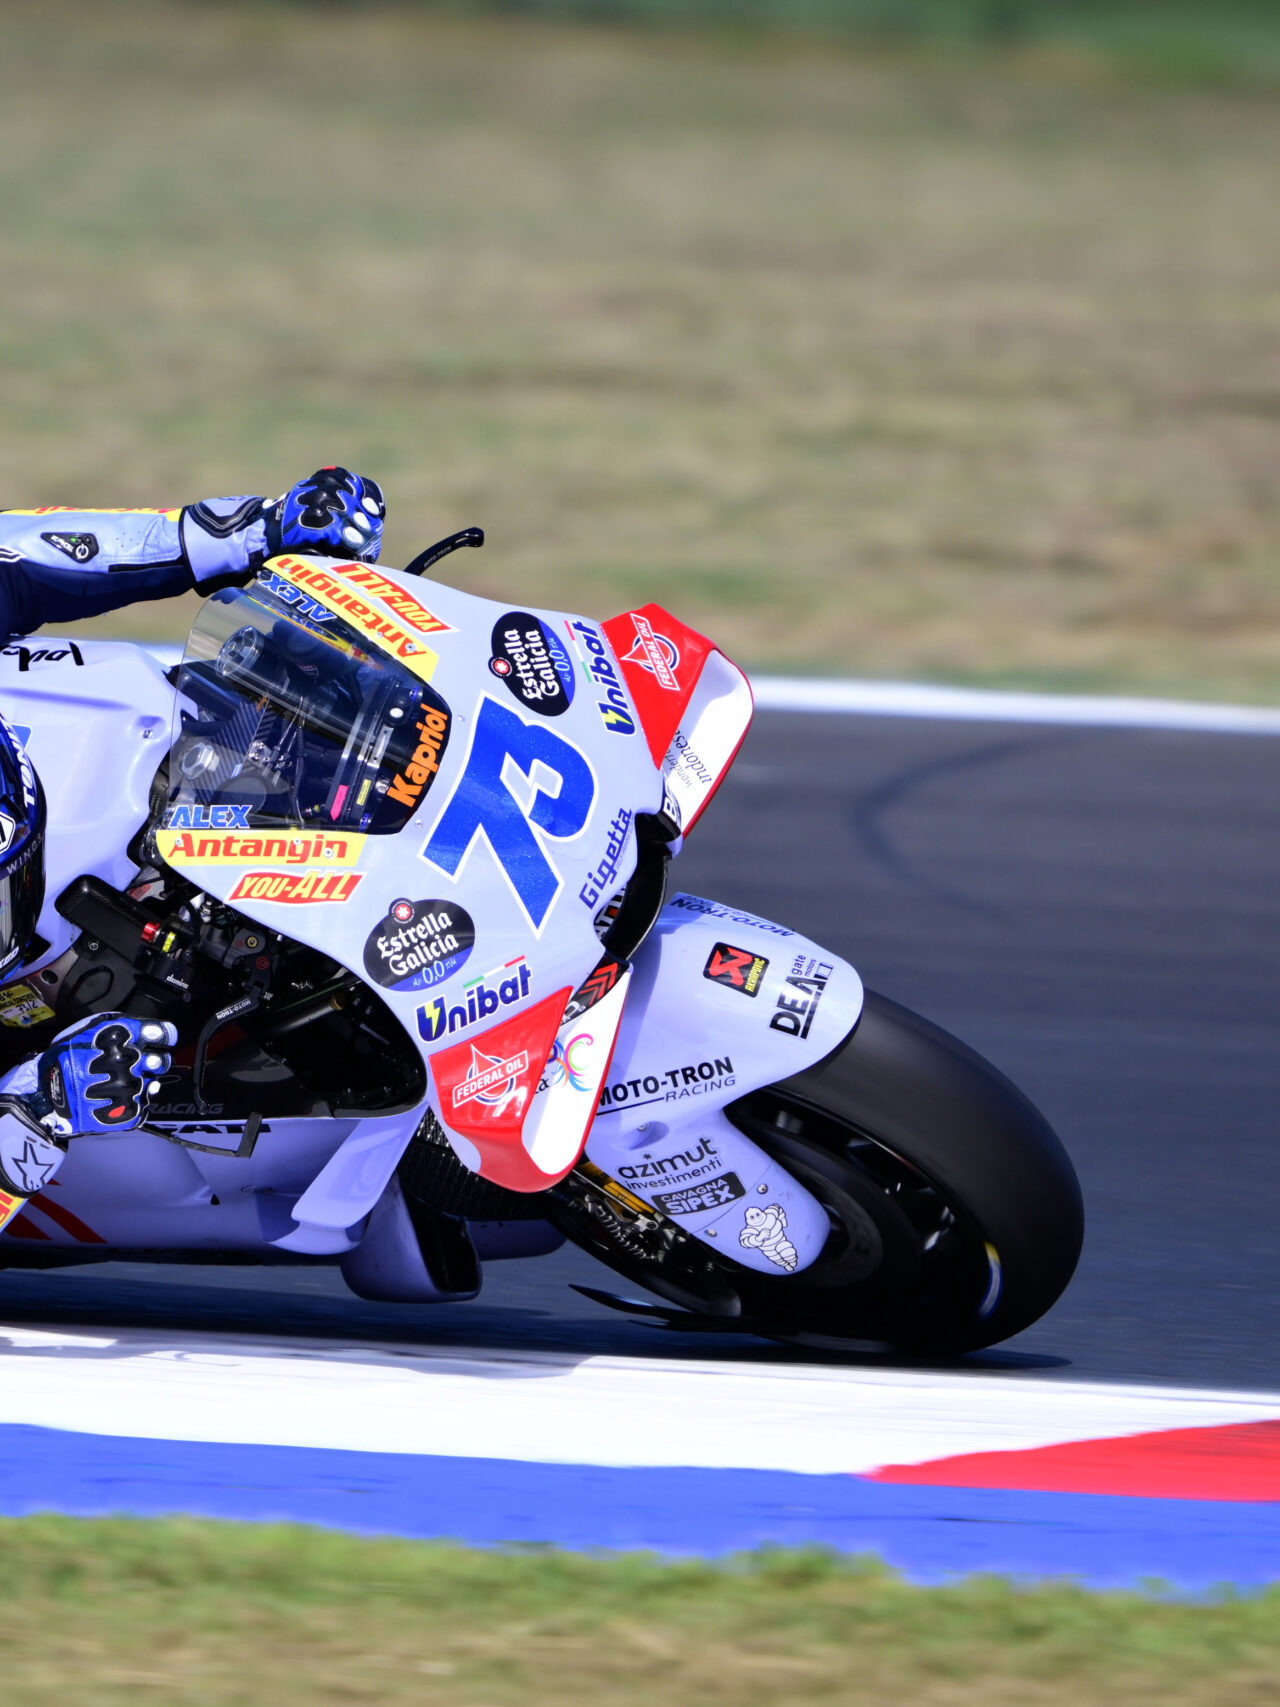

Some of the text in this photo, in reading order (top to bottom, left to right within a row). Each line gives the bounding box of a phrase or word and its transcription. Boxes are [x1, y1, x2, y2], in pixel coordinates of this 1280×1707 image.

[260, 573, 337, 622] ALEX
[276, 557, 428, 659] Antangin
[336, 563, 444, 633] YOU-ALL
[504, 628, 543, 700] Estrella
[525, 629, 560, 696] Galicia
[637, 622, 673, 686] FEDERAL OIL
[571, 620, 636, 736] Unibat
[387, 703, 449, 809] Kapriol
[168, 805, 254, 829] ALEX
[417, 690, 599, 940] 73
[6, 832, 43, 875] WINGS
[168, 833, 348, 864] Antangin
[578, 808, 633, 910] Gigetta
[238, 870, 355, 899] YOU-ALL
[377, 912, 453, 959] Estrella
[671, 898, 795, 937] MOTO-TRON
[389, 934, 459, 976] Galicia
[791, 954, 807, 976] gate
[416, 963, 531, 1042] Unibat
[456, 1058, 524, 1100] FEDERAL OIL
[599, 1057, 734, 1106] MOTO-TRON
[665, 1075, 736, 1102] RACING
[618, 1137, 717, 1179] azimut
[625, 1157, 722, 1190] investimenti
[660, 1178, 728, 1201] CAVAGNA
[666, 1185, 735, 1214] SIPEX
